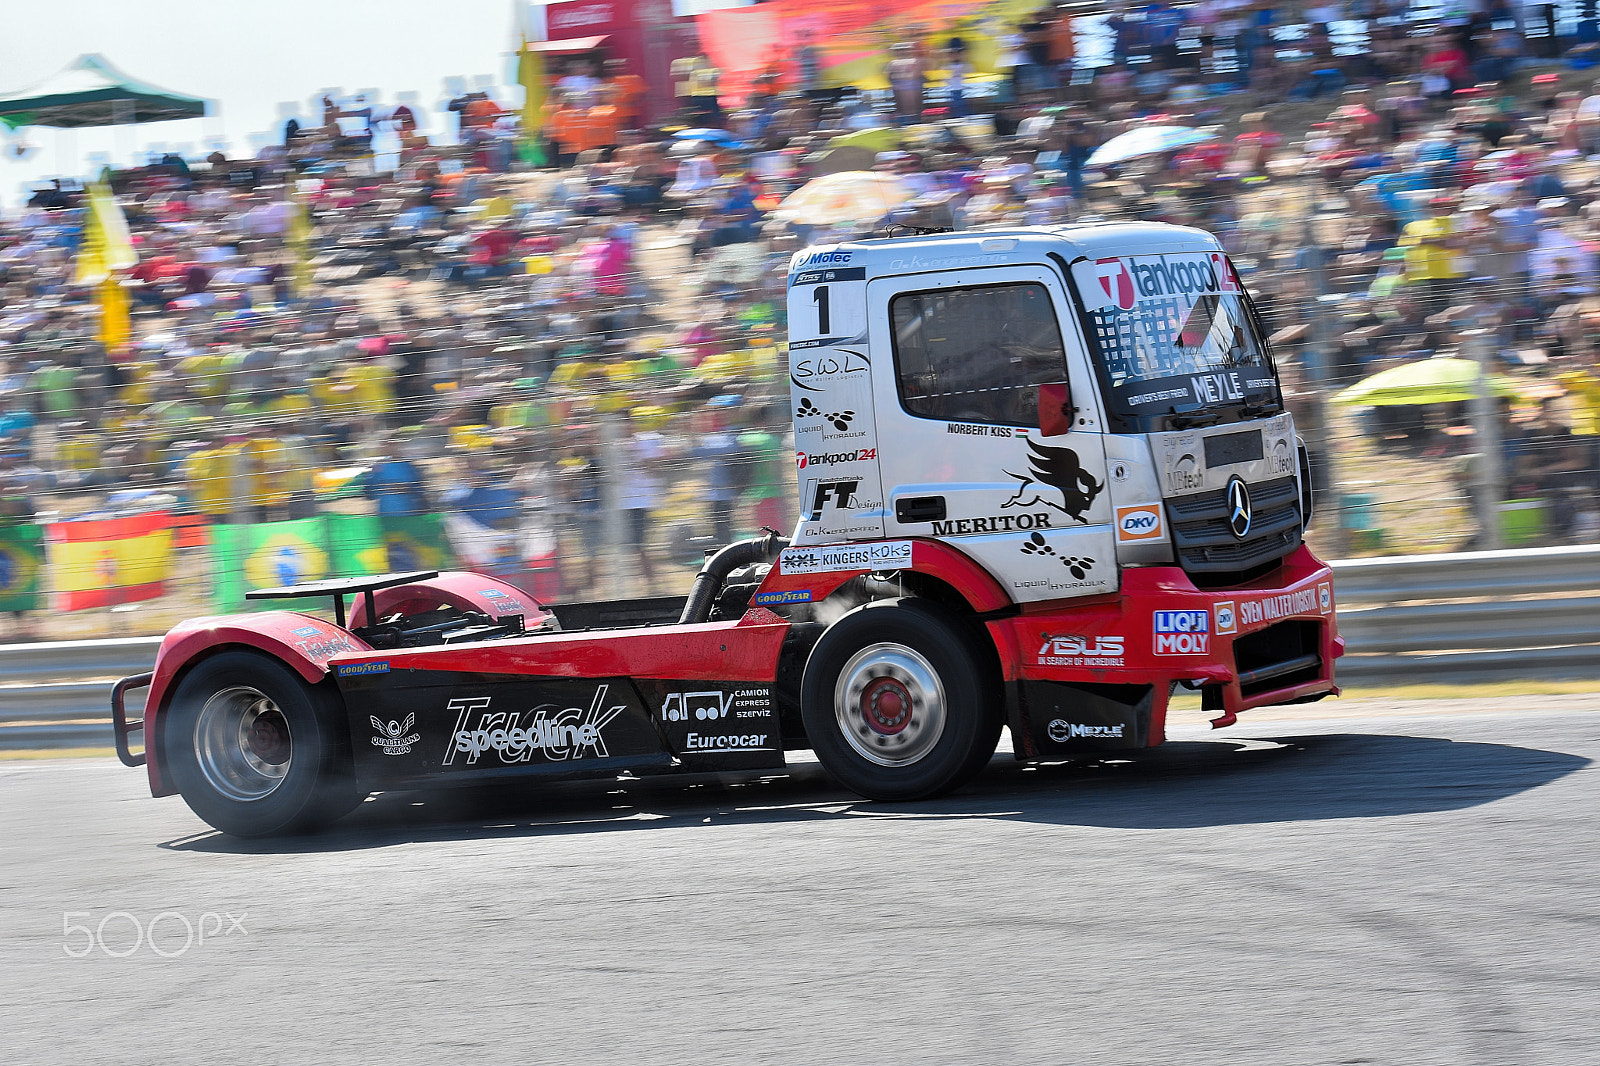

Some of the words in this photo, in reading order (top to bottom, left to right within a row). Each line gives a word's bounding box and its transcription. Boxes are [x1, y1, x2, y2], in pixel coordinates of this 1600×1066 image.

[813, 285, 830, 335] 1
[1190, 372, 1245, 403] MEYLE
[947, 423, 989, 436] NORBERT
[990, 426, 1012, 438] KISS
[808, 448, 877, 467] tankpool24
[931, 512, 1052, 536] MERITOR
[1123, 516, 1156, 530] DKV
[823, 550, 869, 566] KINGERS
[757, 591, 810, 604] GOODYEAR
[1262, 594, 1293, 620] WALTER
[1157, 612, 1207, 633] LIQUI
[1038, 636, 1125, 656] ASUS
[1157, 634, 1208, 653] MOLY
[340, 663, 388, 675] GOODYEAR
[1046, 656, 1073, 666] SEARCH
[1074, 657, 1084, 666] OF
[1084, 657, 1125, 667] INCREDIBLE
[734, 688, 769, 697] CAMION
[735, 699, 770, 707] EXPRESS
[441, 684, 627, 766] Truck
[455, 718, 598, 758] speedline
[686, 732, 768, 750] Europcar
